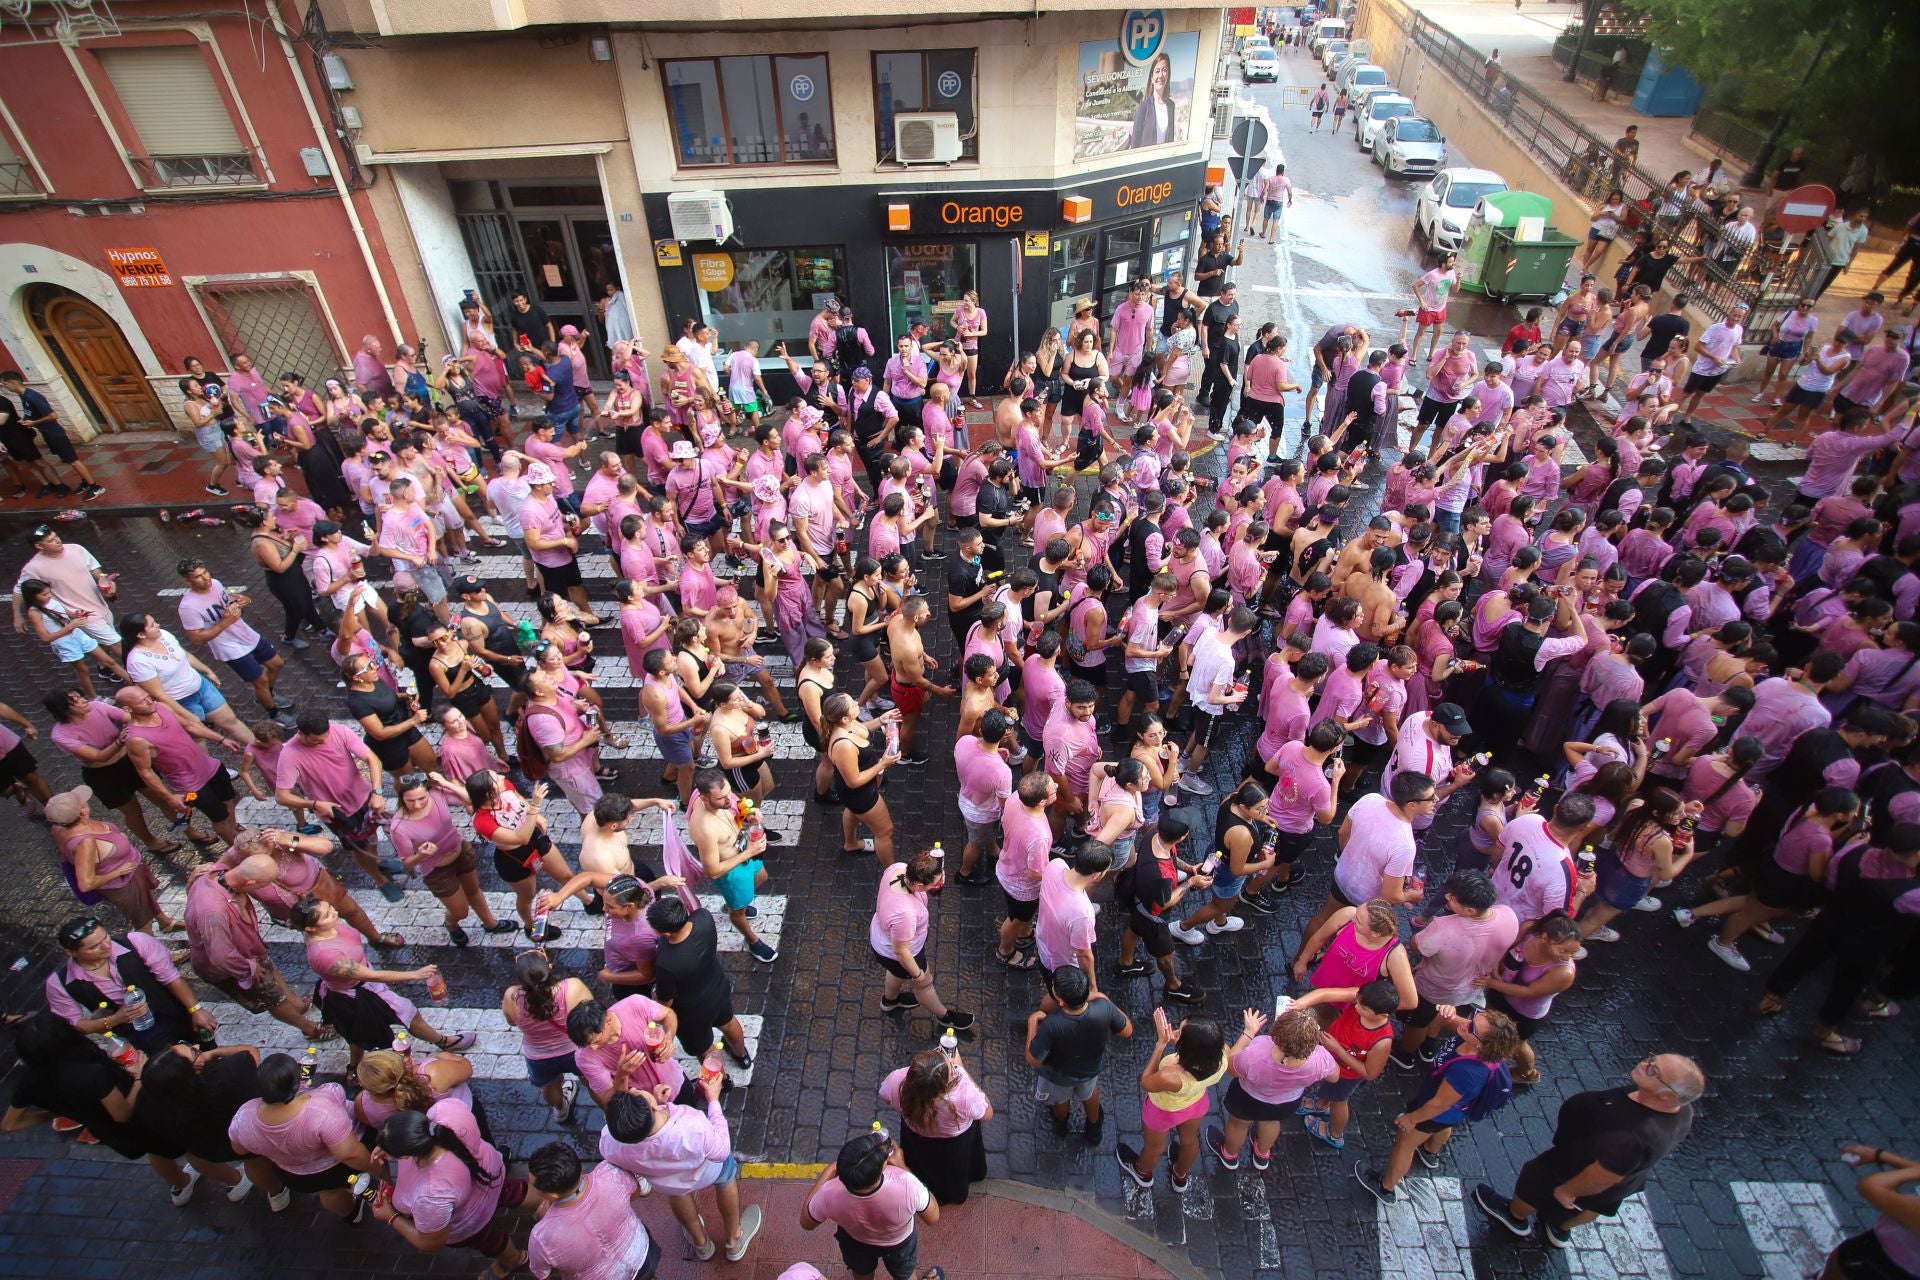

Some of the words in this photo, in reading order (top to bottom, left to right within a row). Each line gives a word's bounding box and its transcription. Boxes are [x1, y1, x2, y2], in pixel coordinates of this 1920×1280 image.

[1130, 17, 1159, 50] PP
[943, 79, 957, 91] PP
[1087, 74, 1106, 84] SEVE
[795, 82, 810, 95] PP
[1116, 181, 1172, 207] Orange
[941, 202, 1023, 228] Orange
[108, 250, 157, 264] Hypnos
[700, 259, 726, 268] Fibra
[114, 264, 167, 276] VENDE
[1507, 841, 1533, 890] 18
